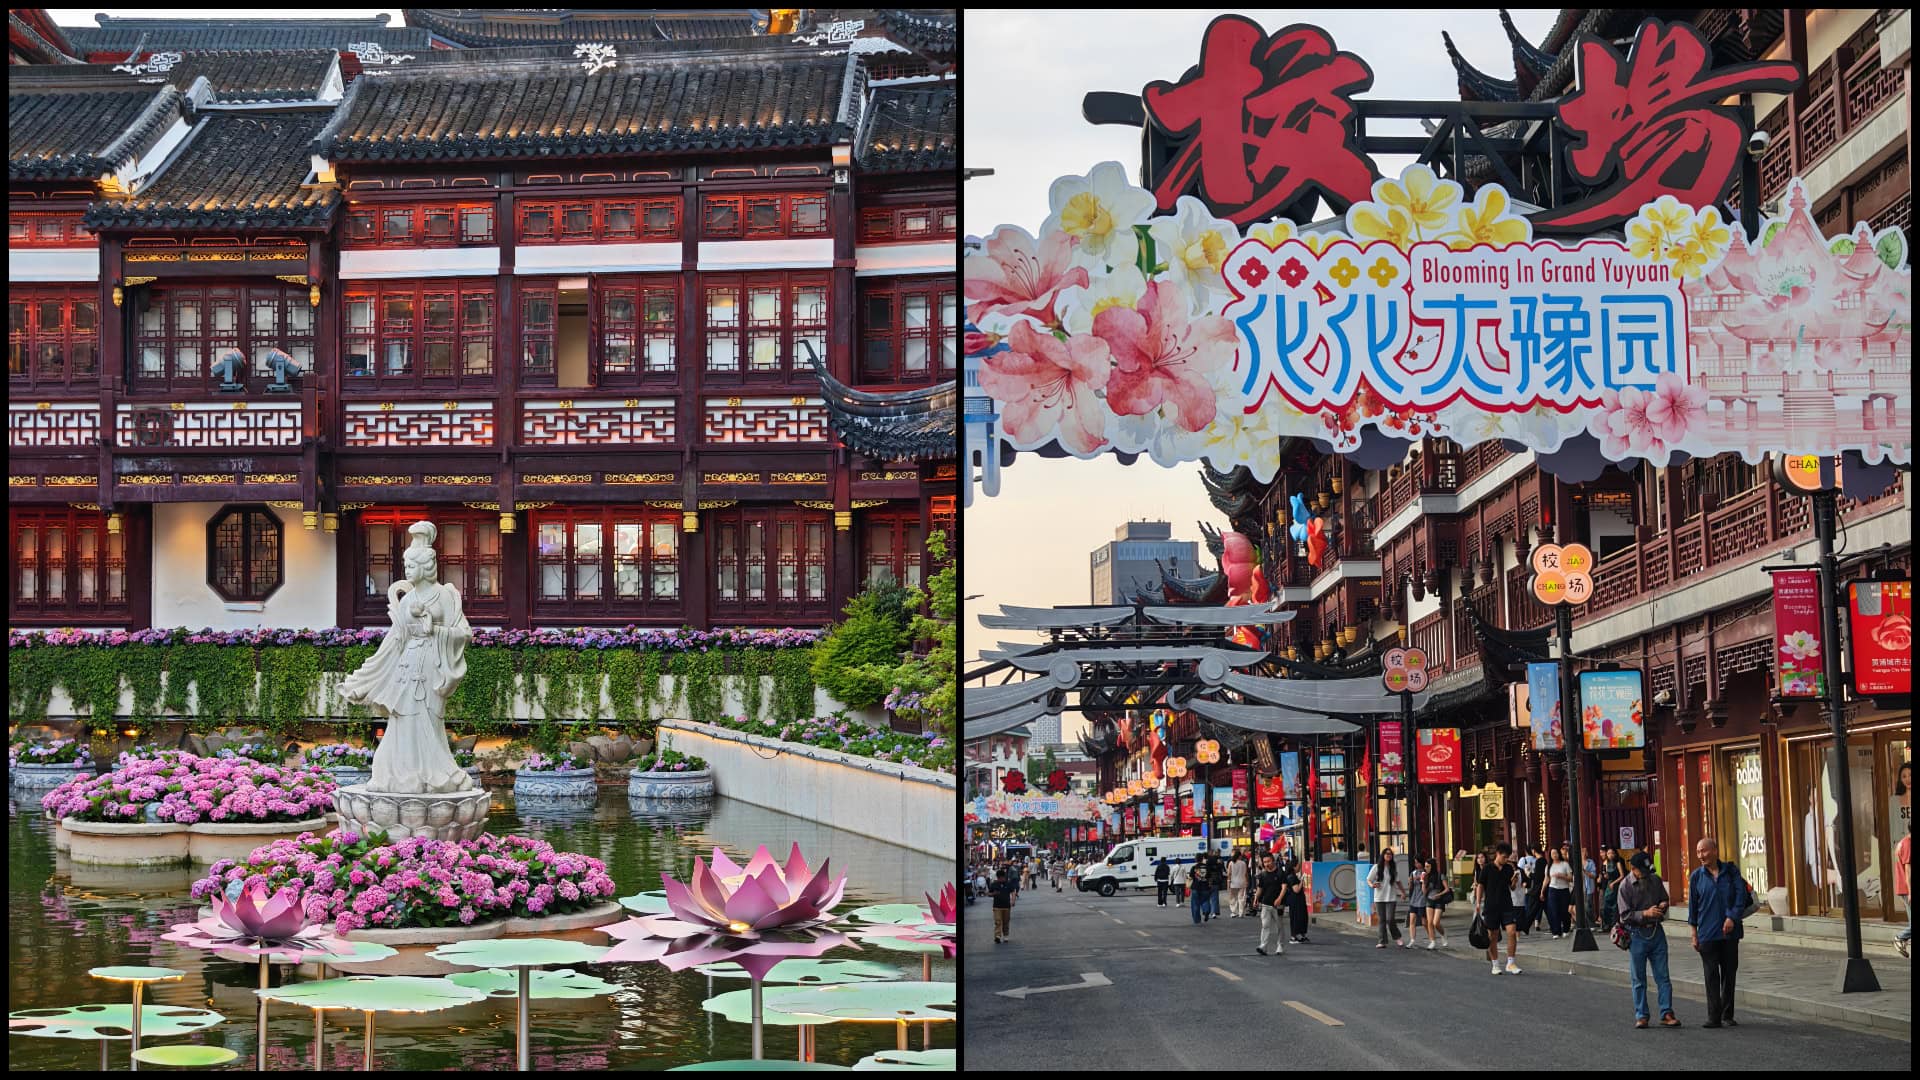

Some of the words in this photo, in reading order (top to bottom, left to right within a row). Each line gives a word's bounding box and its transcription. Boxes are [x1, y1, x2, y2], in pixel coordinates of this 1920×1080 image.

[1422, 258, 1509, 290] Blooming
[1517, 258, 1534, 283] In
[1541, 257, 1595, 283] Grand
[1601, 257, 1670, 289] Yuyuan
[1788, 460, 1820, 469] CHAN
[1541, 552, 1559, 569] 校
[1536, 583, 1566, 591] CHANG
[1568, 578, 1584, 593] 场
[1900, 806, 1911, 819] SE
